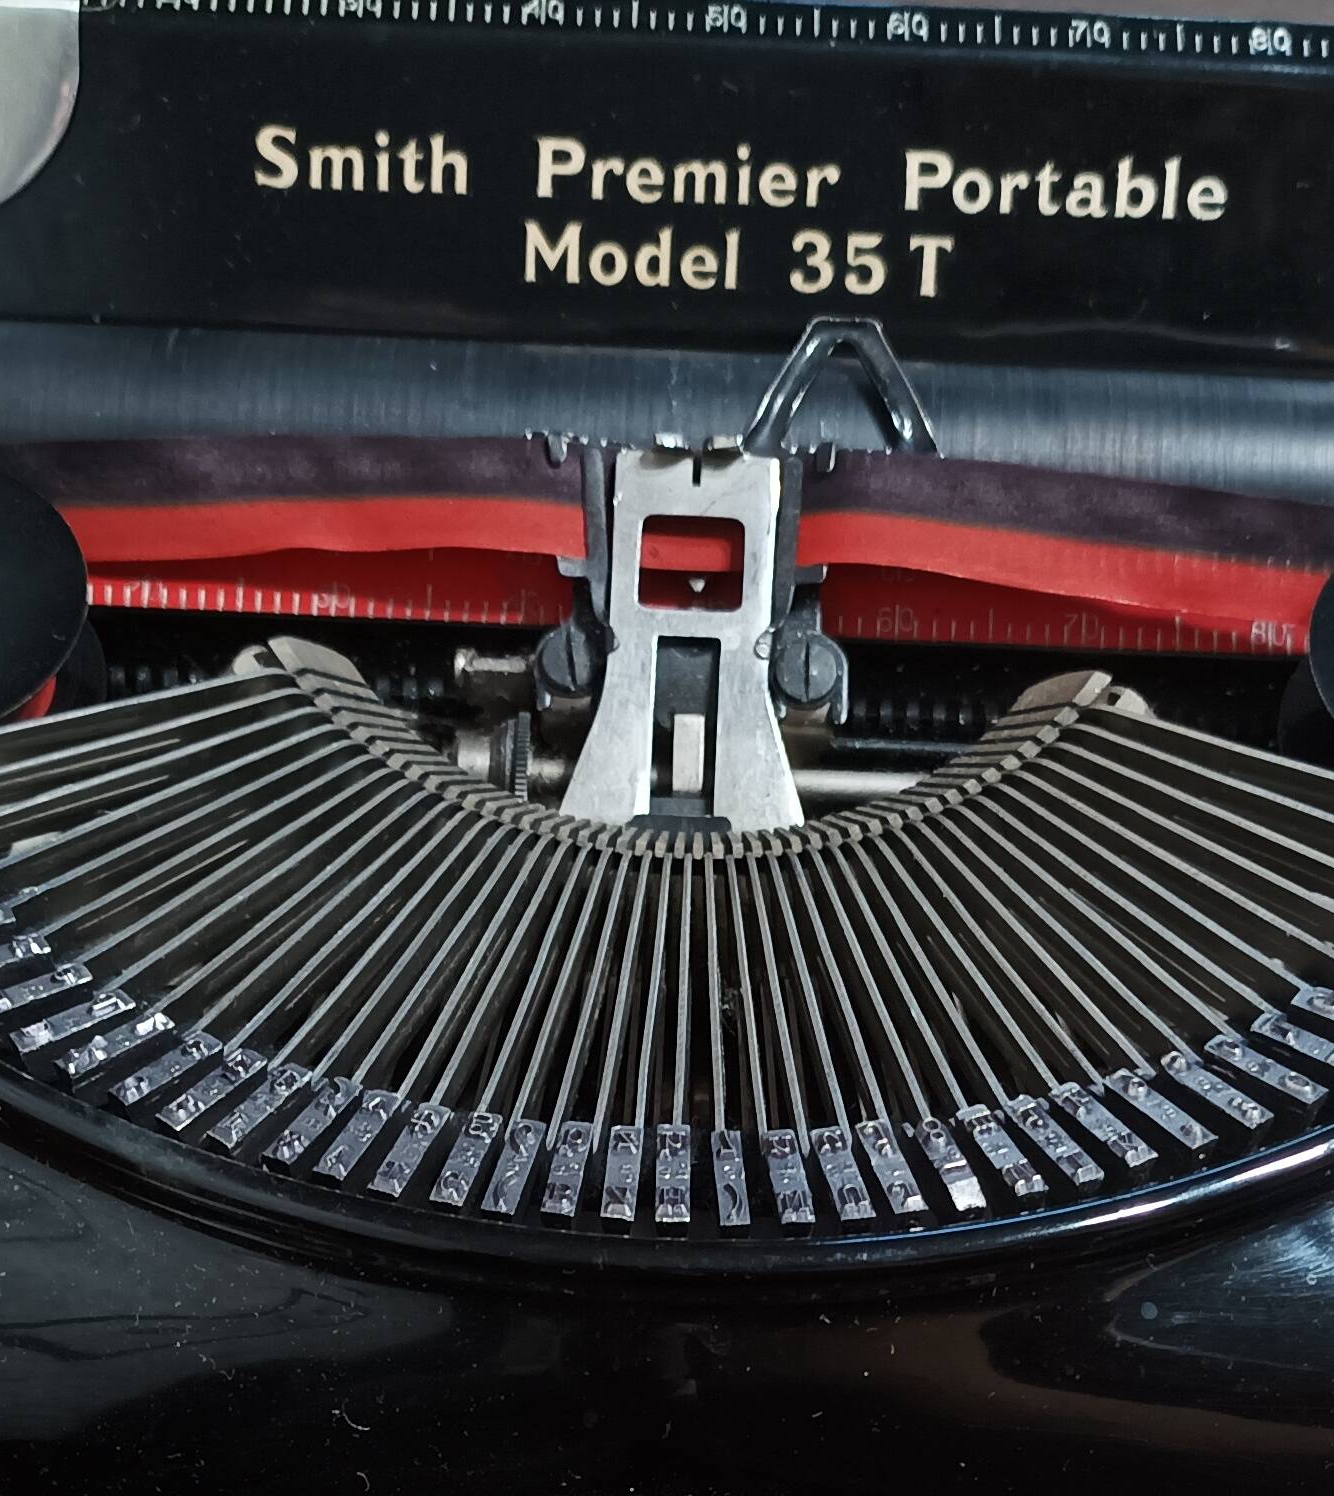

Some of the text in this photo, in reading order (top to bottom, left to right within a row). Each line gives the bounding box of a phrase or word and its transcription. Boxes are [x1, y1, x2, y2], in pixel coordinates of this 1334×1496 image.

[709, 4, 746, 30] 50
[889, 12, 927, 38] 60
[1072, 20, 1108, 45] 70
[1253, 27, 1290, 54] 80
[255, 126, 1227, 220] Smith Premier Portable
[525, 222, 739, 289] Model
